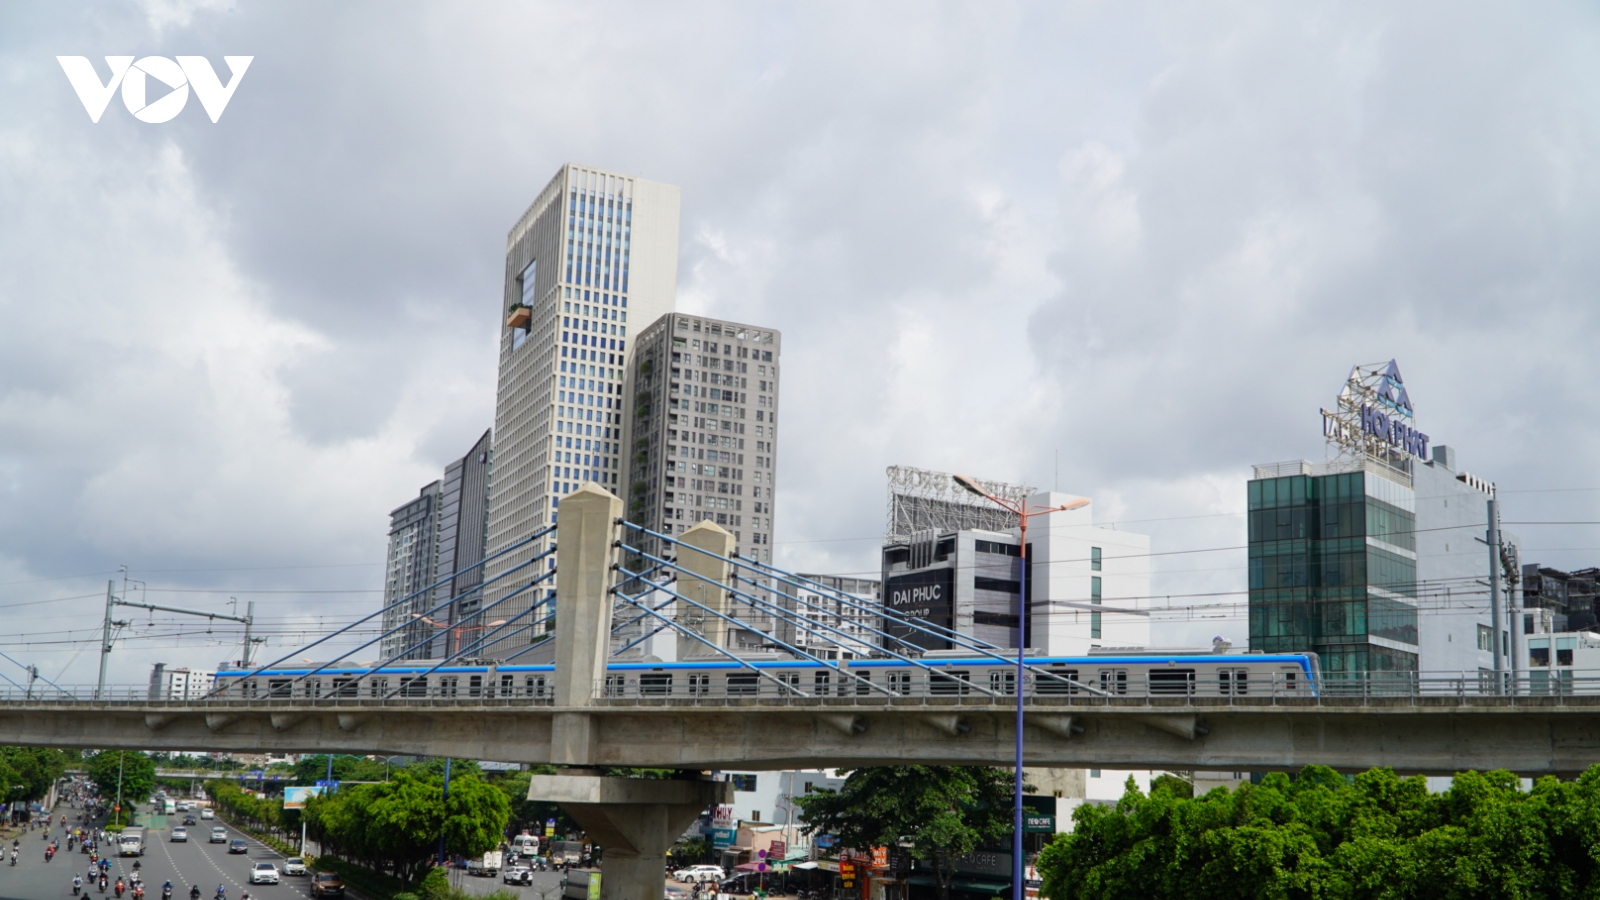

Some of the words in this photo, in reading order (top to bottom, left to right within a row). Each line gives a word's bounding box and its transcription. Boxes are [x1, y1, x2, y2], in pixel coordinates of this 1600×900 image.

[893, 589, 911, 606] DAI
[912, 584, 942, 603] PHUC
[976, 854, 996, 867] CAFE
